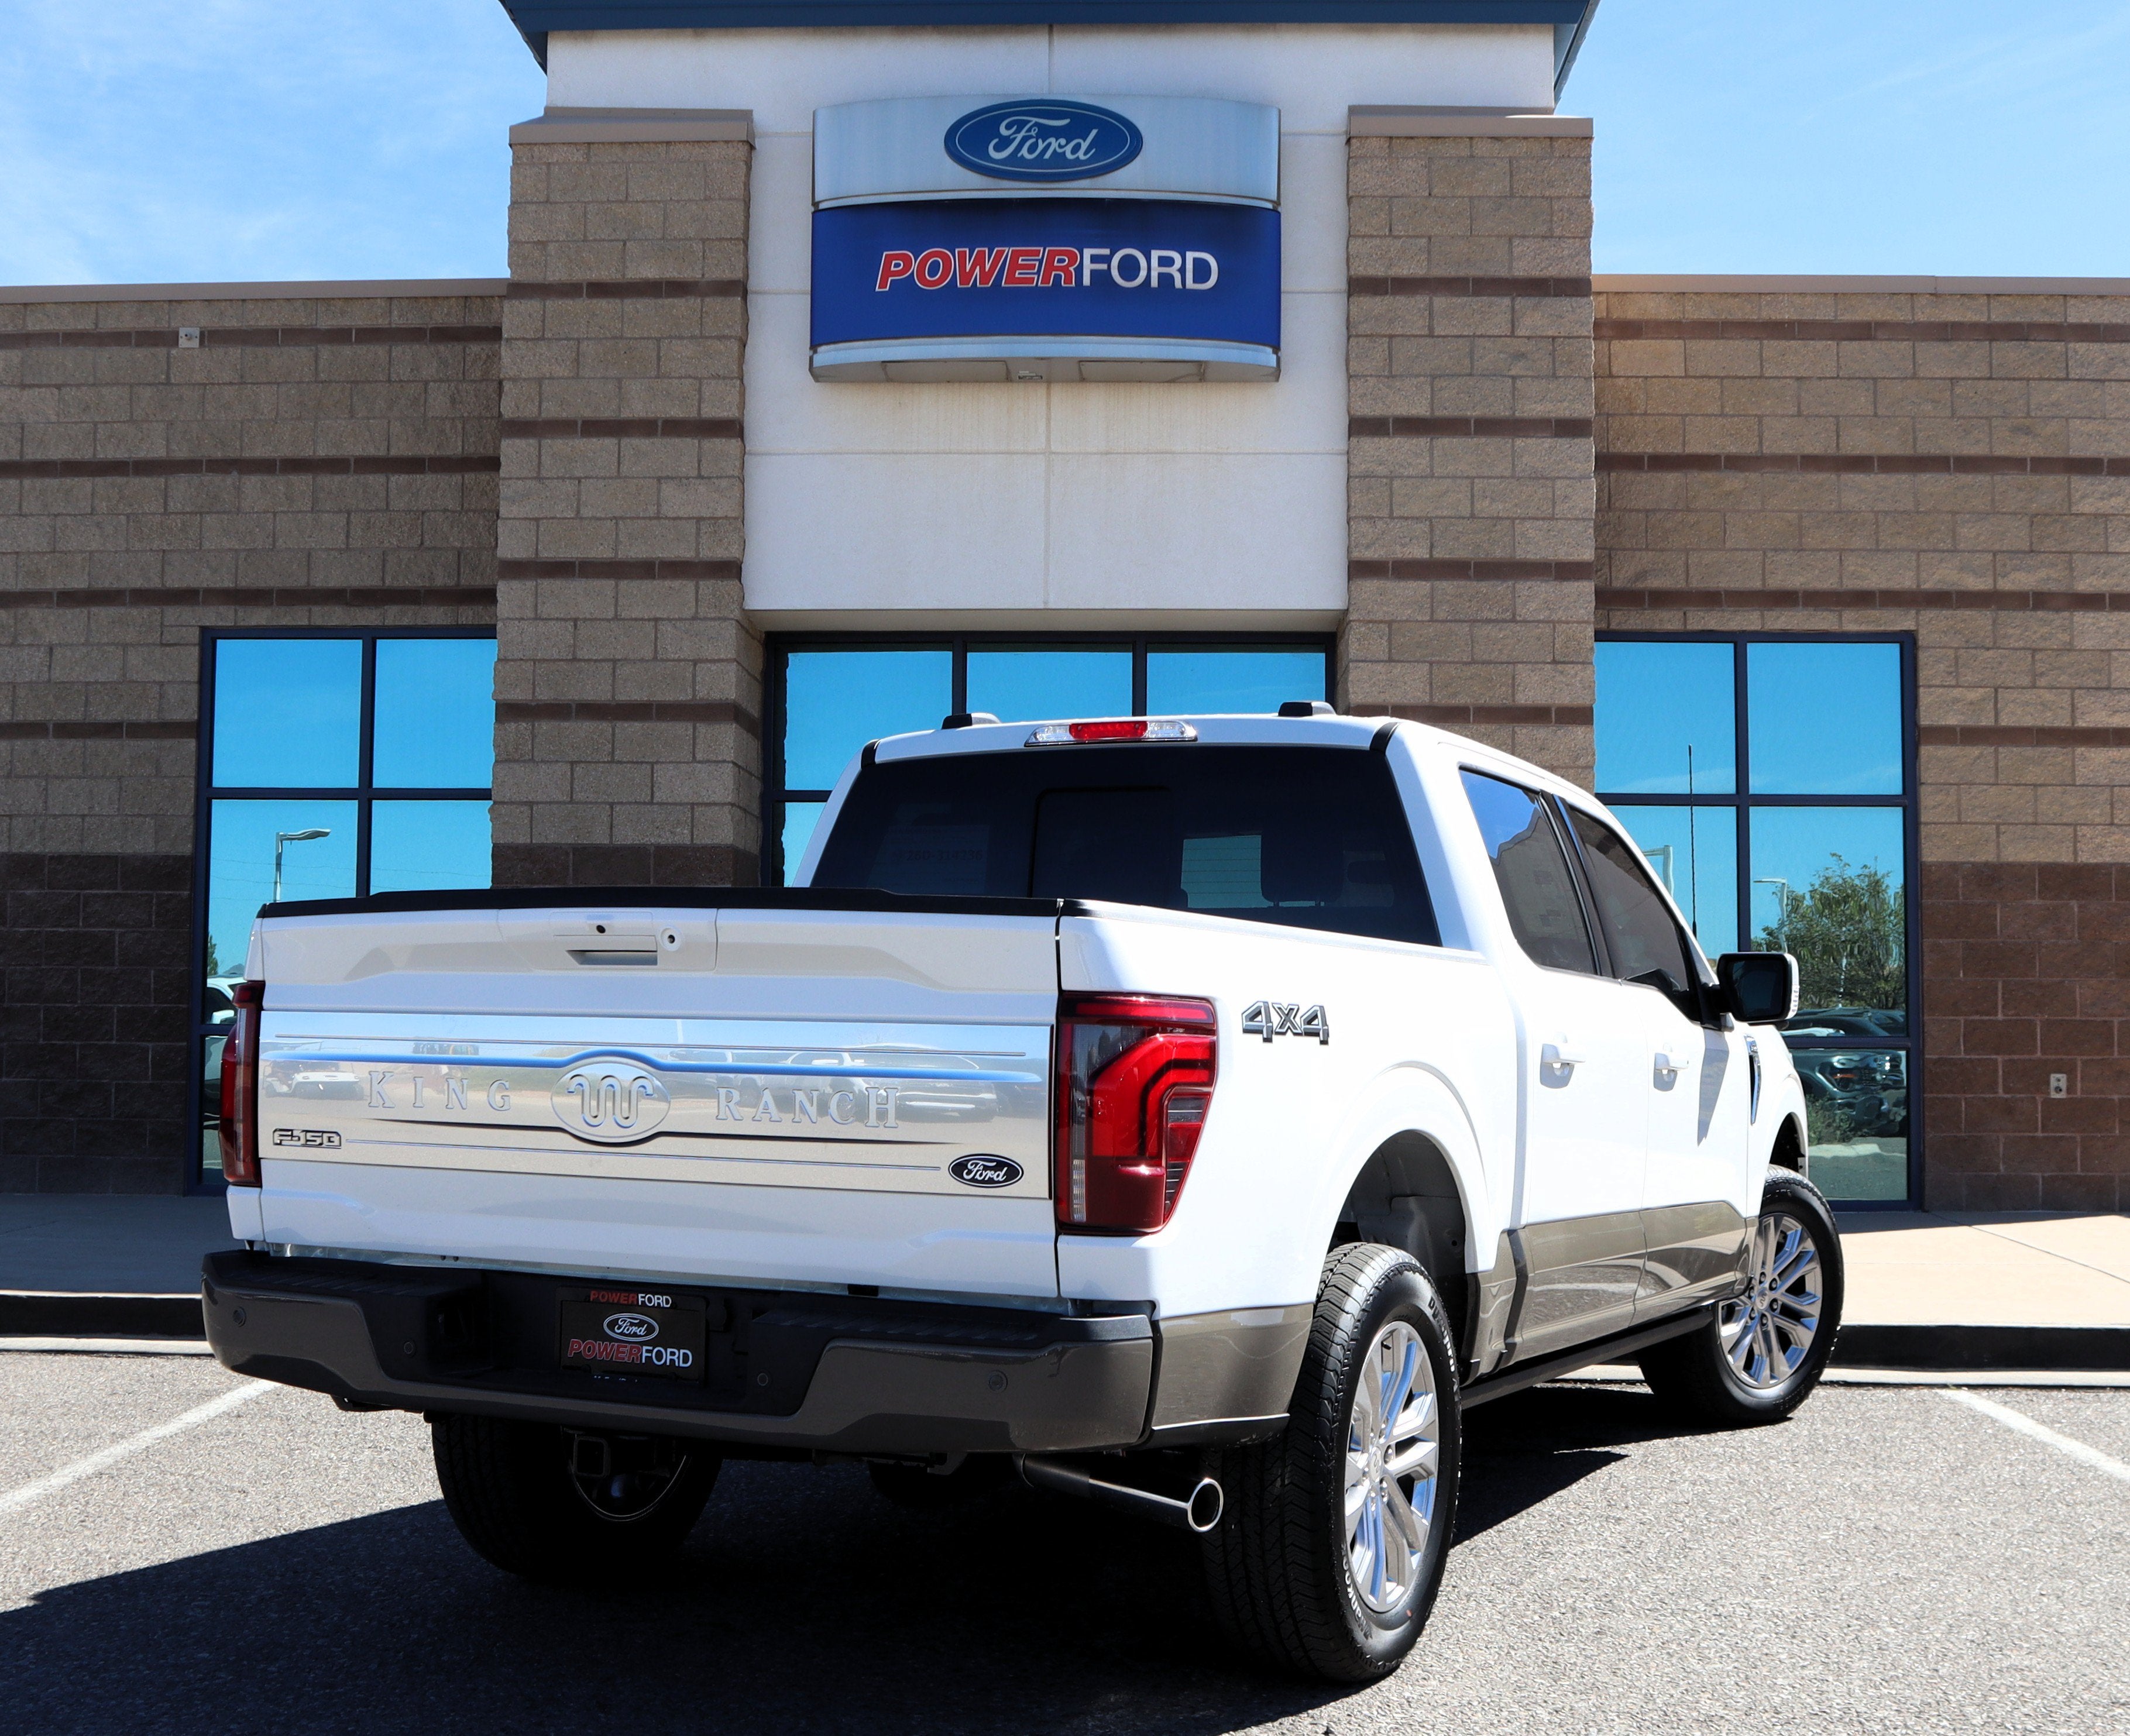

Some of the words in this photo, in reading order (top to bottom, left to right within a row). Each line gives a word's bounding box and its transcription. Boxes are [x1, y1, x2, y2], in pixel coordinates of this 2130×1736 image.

[988, 115, 1099, 161] Ford
[368, 1070, 511, 1112] KING
[716, 1086, 899, 1129] RANCH
[272, 1127, 342, 1149] F-150
[963, 1160, 1008, 1181] Ford
[614, 1317, 647, 1336] Ford
